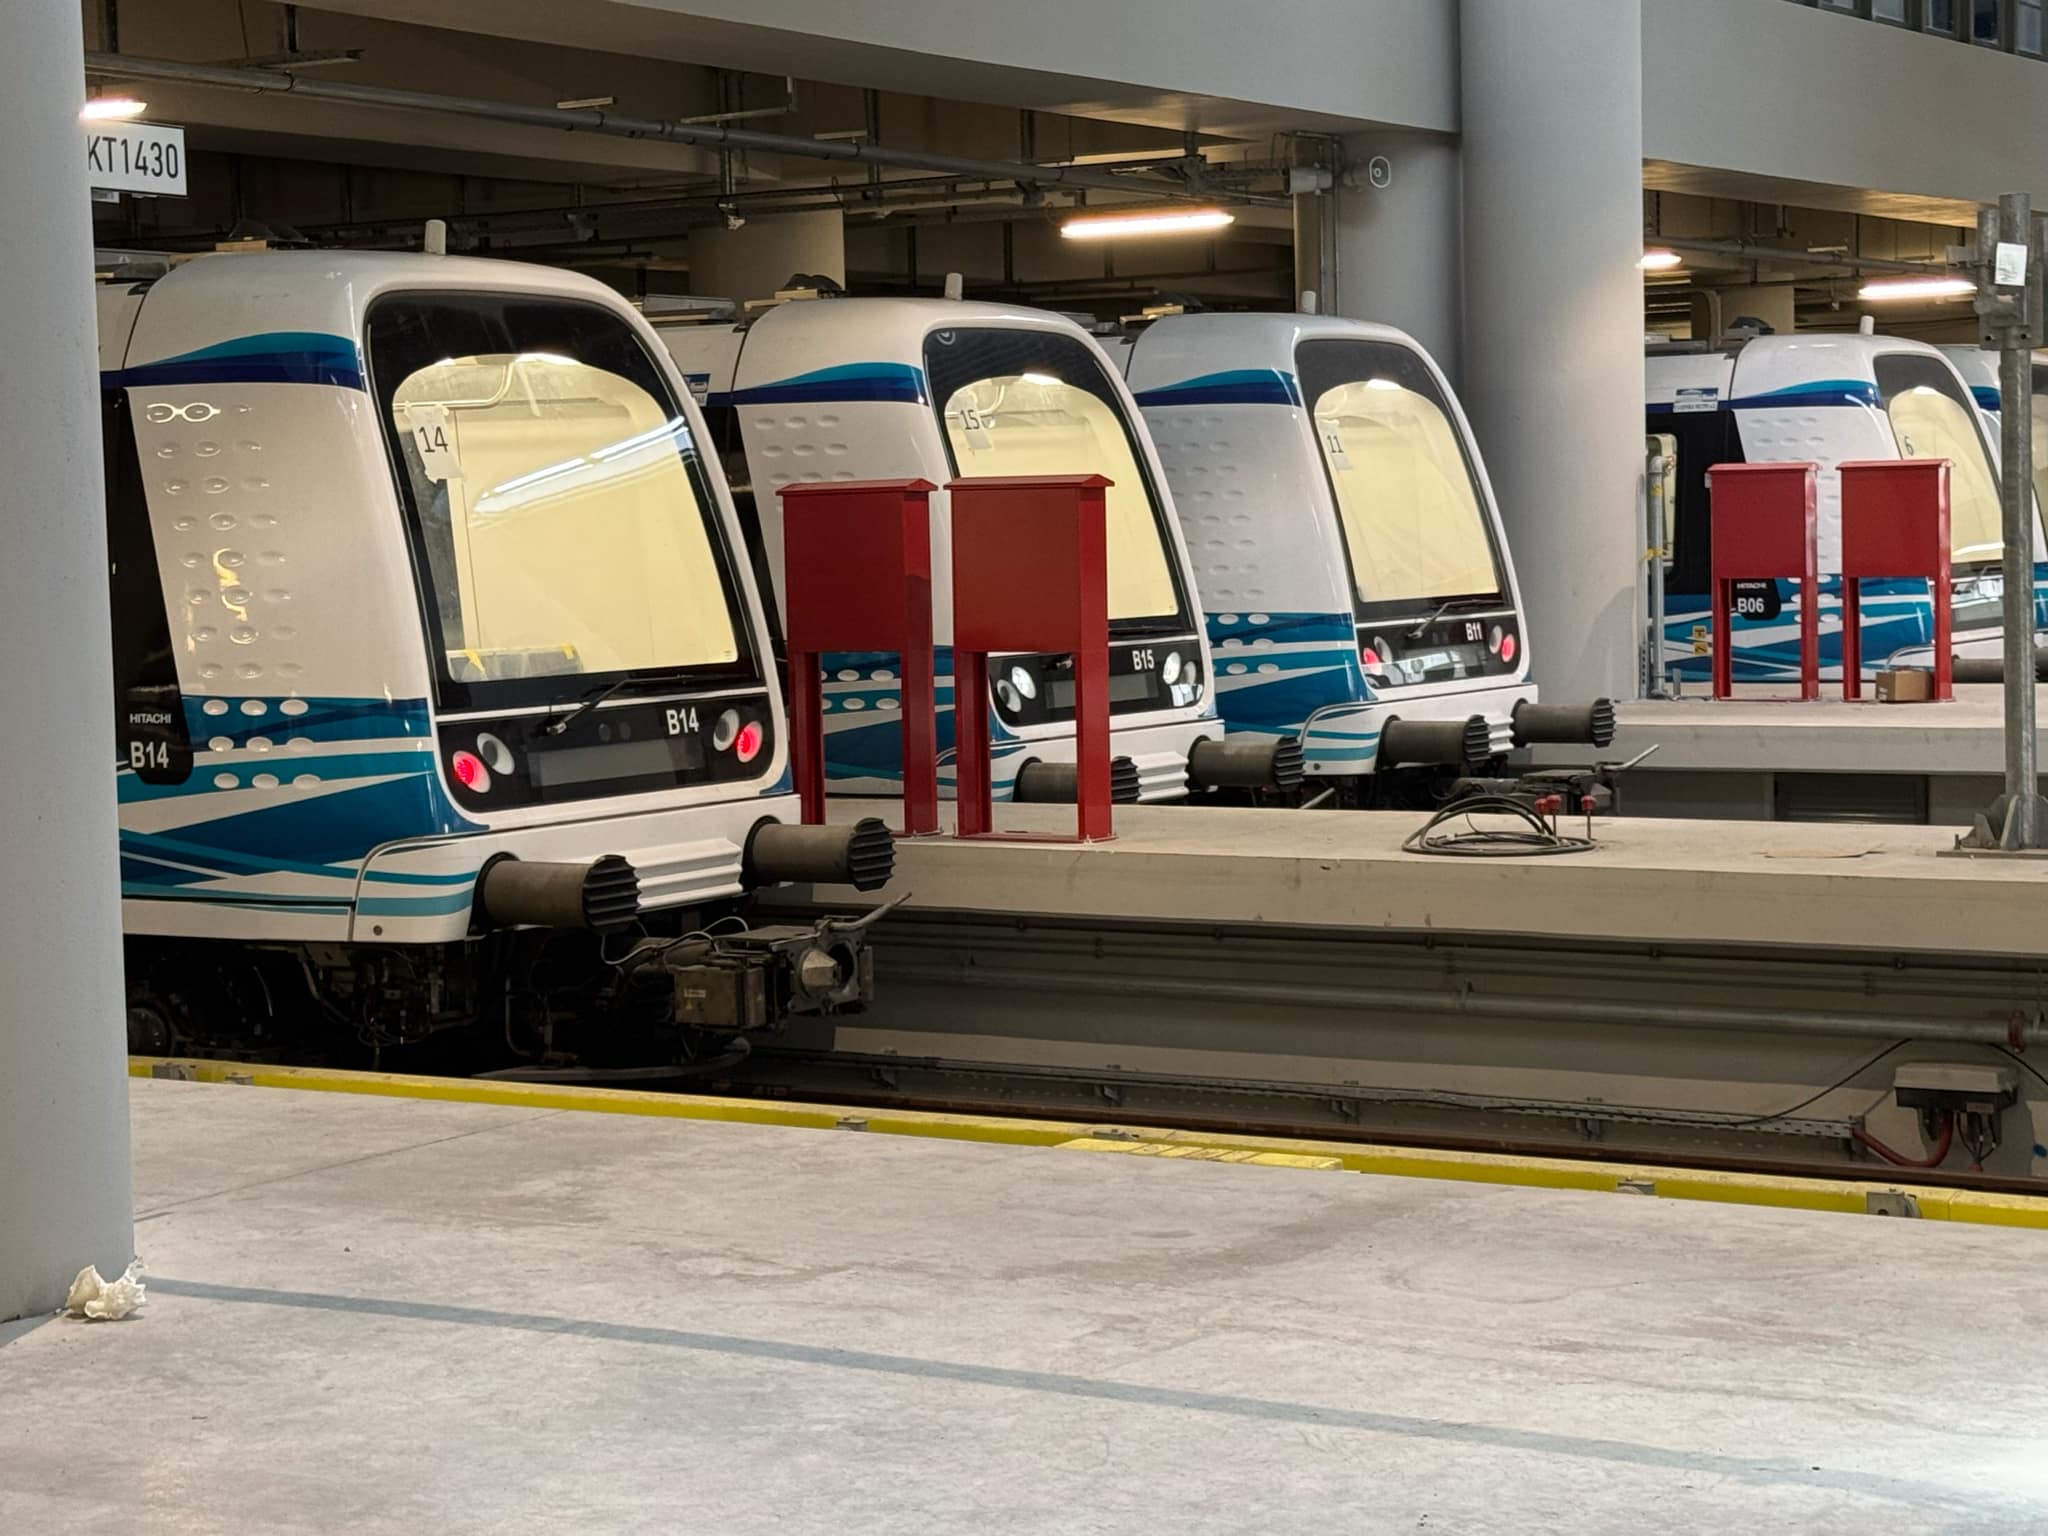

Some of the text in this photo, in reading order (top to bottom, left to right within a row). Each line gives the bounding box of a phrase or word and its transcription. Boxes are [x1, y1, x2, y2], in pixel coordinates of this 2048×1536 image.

[88, 135, 178, 179] KT1430
[960, 409, 980, 430] 15
[419, 426, 448, 453] 14
[1327, 434, 1344, 453] 11
[1904, 435, 1914, 457] 6
[1737, 597, 1765, 613] B06
[1465, 621, 1482, 640] B11
[1132, 649, 1155, 670] B15
[129, 713, 171, 724] HITACHI
[666, 707, 699, 735] B14
[130, 741, 169, 769] B14
